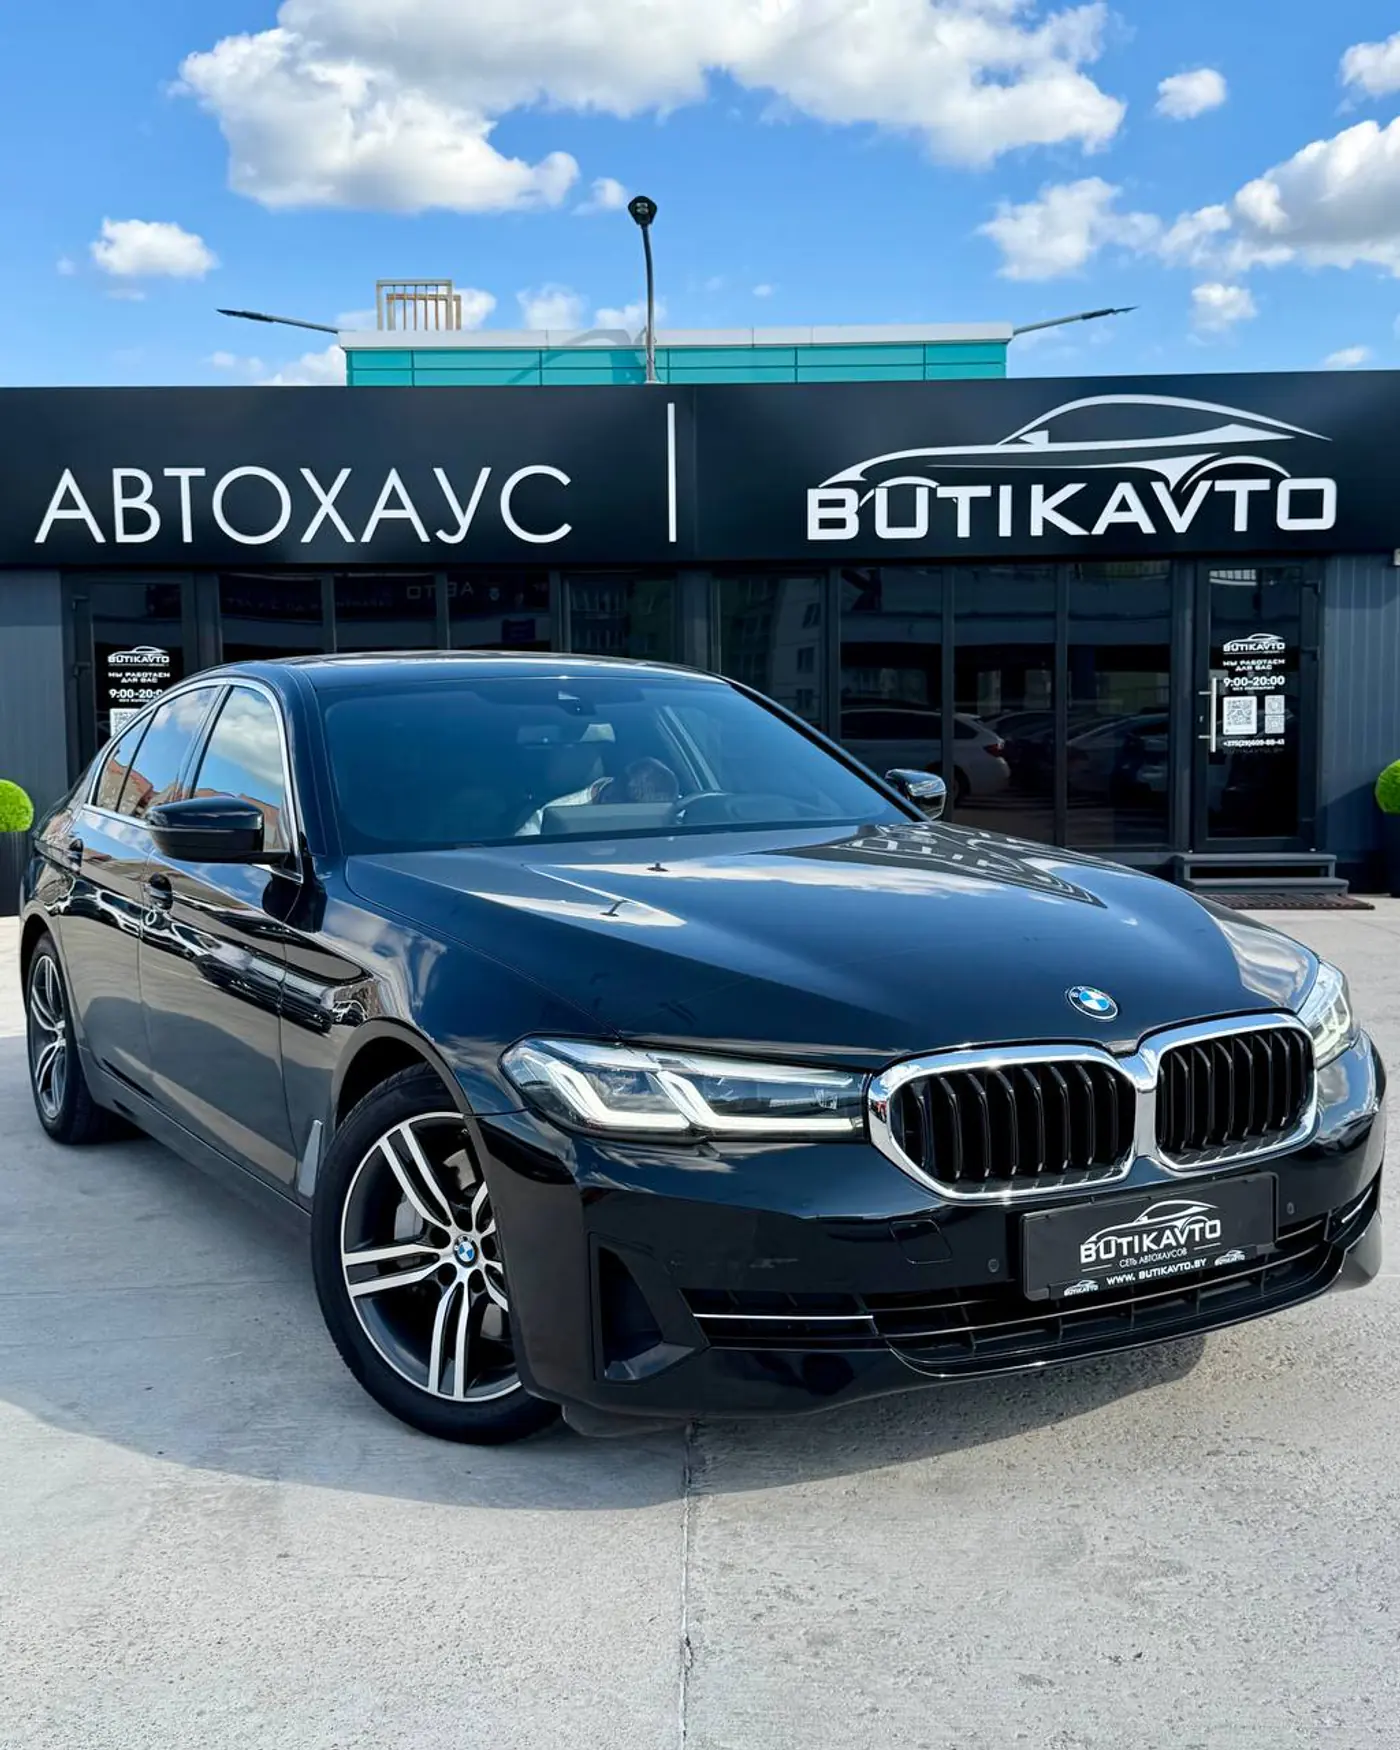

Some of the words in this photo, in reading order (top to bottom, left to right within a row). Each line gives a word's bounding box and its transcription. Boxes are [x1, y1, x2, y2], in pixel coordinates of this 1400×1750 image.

[35, 465, 572, 544] АВТОХАУС
[807, 476, 1338, 541] BUTIKAVTO
[108, 655, 170, 663] BUTIKAVTO
[1222, 642, 1286, 651] BUTIKAVTO
[1223, 676, 1286, 687] 9:00-20:00
[1080, 1219, 1222, 1264] BUTIKAVTO
